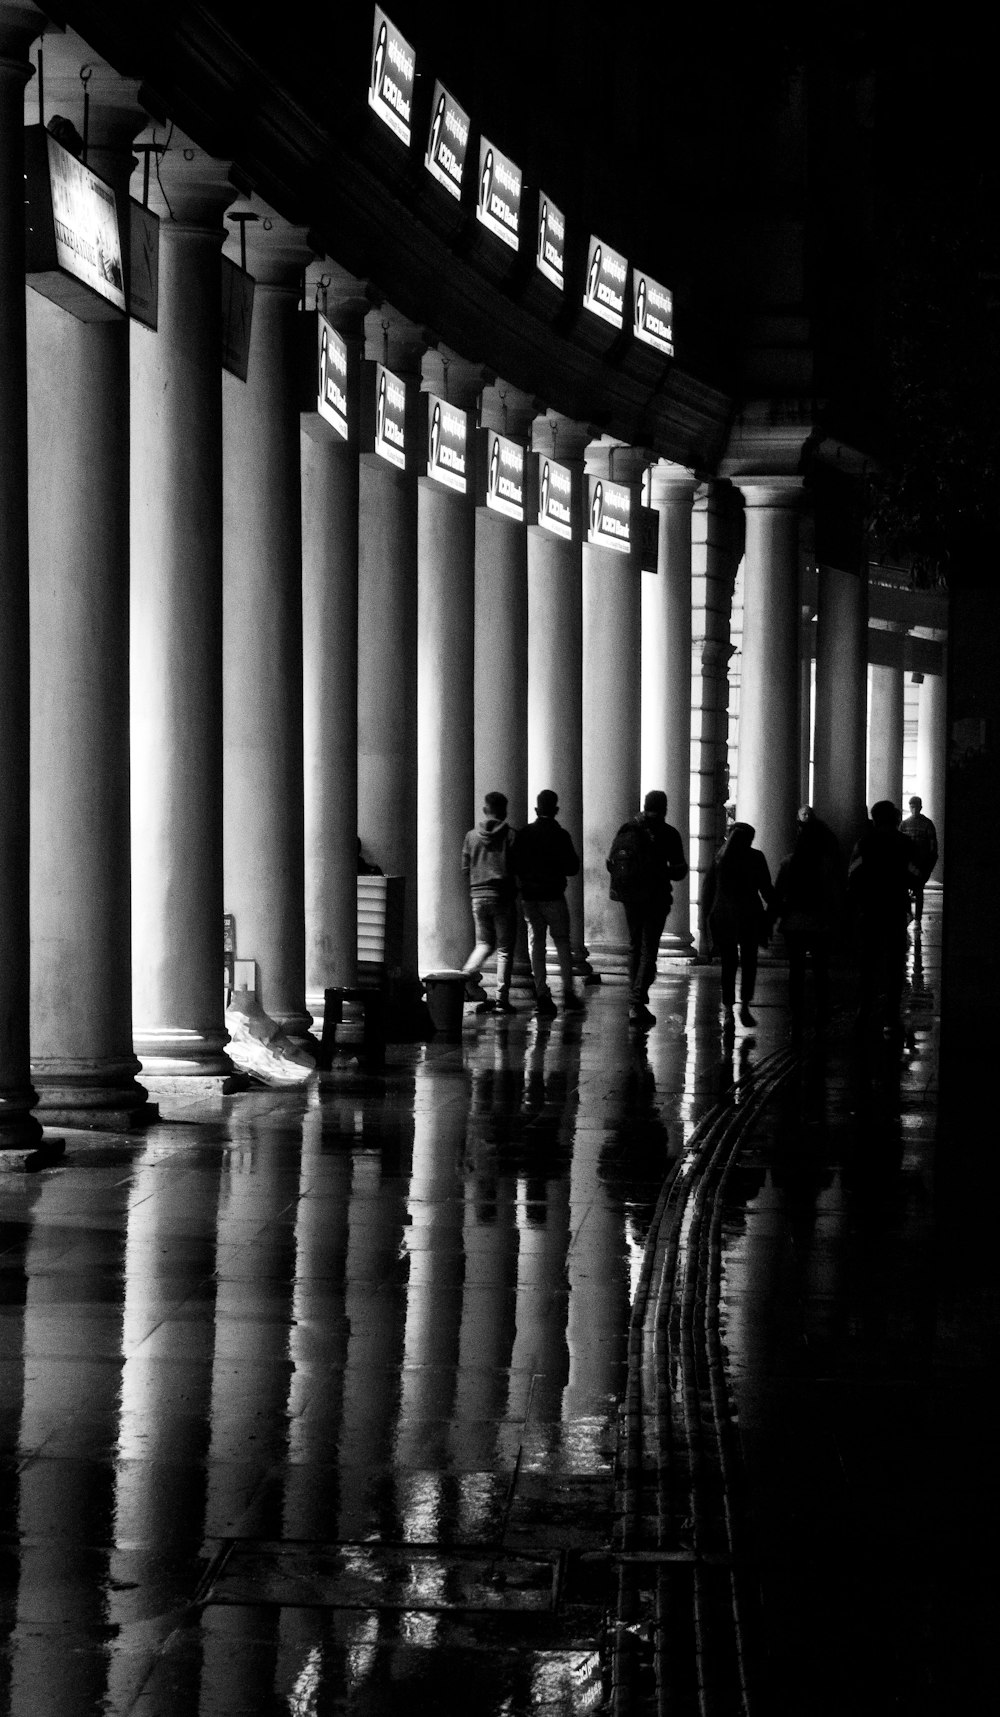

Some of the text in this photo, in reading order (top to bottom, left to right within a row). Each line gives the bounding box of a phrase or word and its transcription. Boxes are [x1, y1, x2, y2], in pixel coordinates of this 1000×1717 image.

[395, 89, 410, 123] Bank
[449, 154, 463, 184] Bank
[503, 205, 518, 232] Bank
[609, 291, 623, 312] Bank
[658, 321, 671, 341] Bank
[452, 451, 464, 473] Bank
[615, 521, 629, 538] Bank
